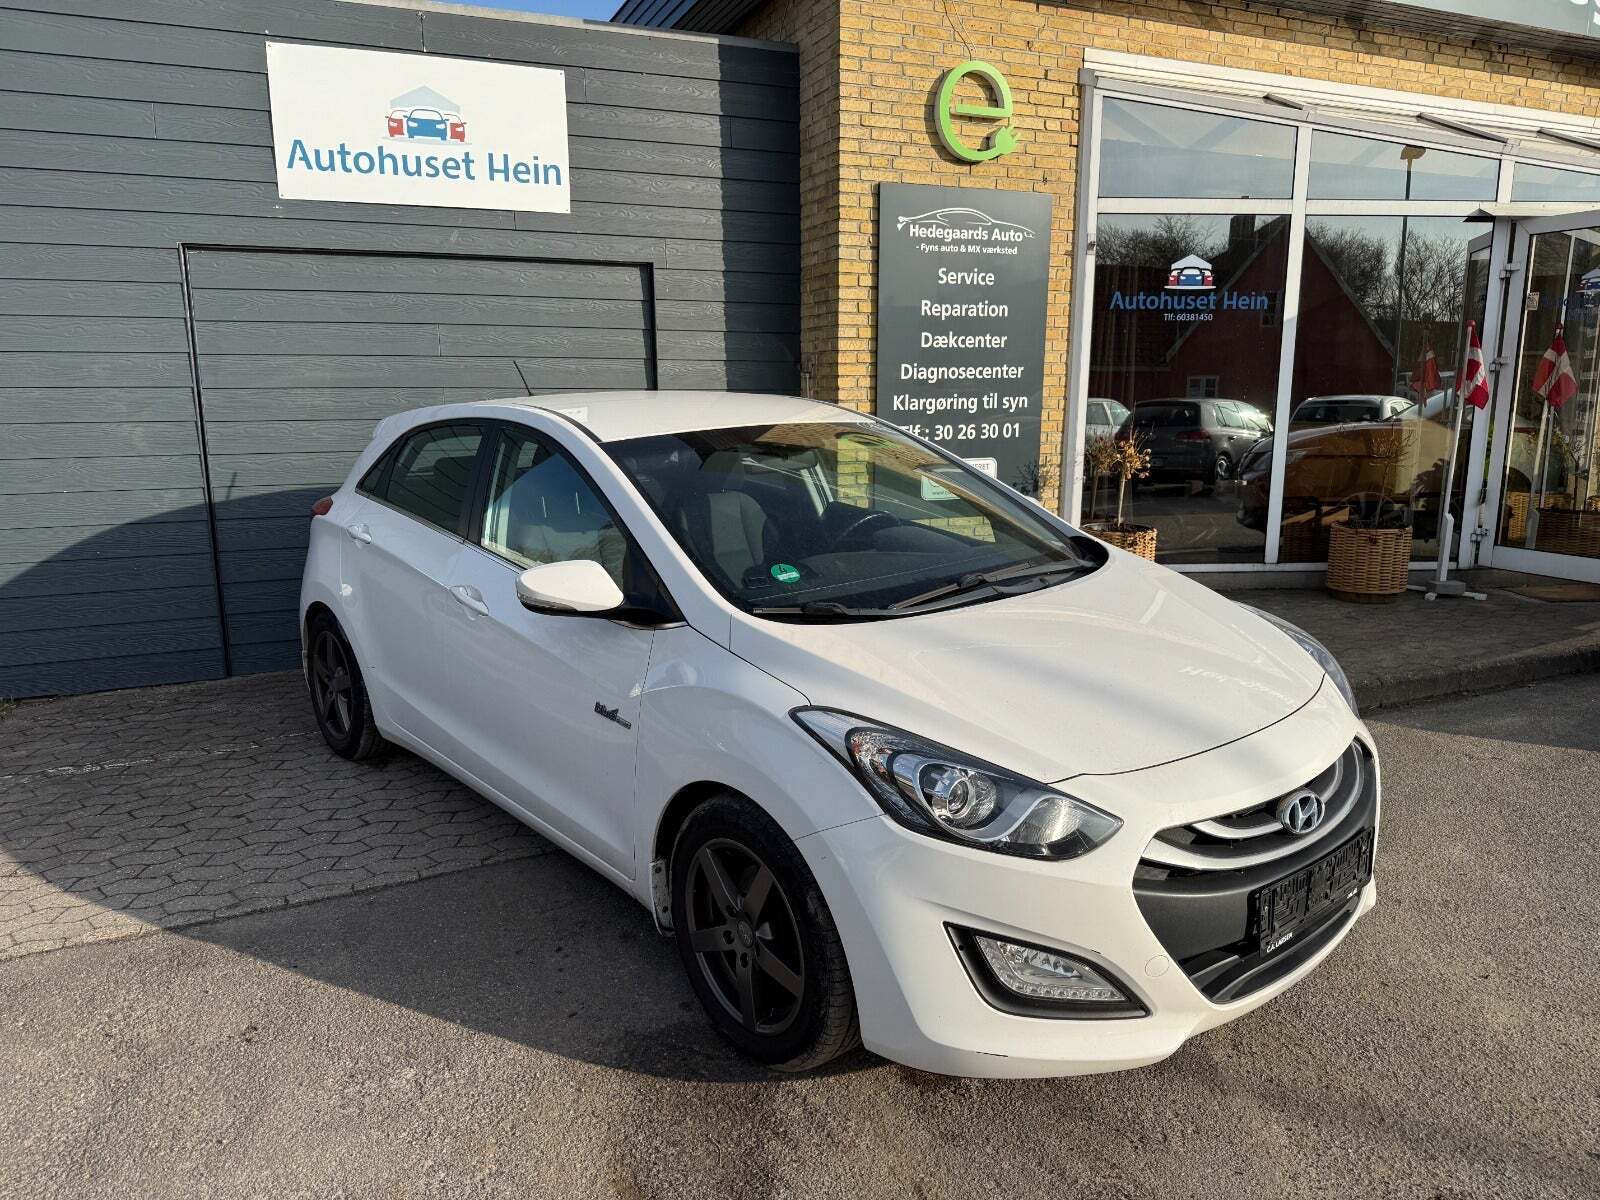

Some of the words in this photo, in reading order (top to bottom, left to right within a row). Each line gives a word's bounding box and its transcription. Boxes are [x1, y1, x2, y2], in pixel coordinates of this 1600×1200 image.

[286, 138, 476, 181] Autohuset
[487, 152, 563, 186] Hein
[909, 224, 989, 242] Hedegaards
[991, 228, 1024, 242] Auto
[920, 243, 939, 254] Fyns
[940, 244, 959, 253] auto
[960, 244, 967, 253] &
[967, 245, 981, 253] MX
[982, 246, 1018, 255] værksted
[938, 267, 995, 286] Service
[921, 299, 1009, 321] Reparation
[1109, 290, 1218, 311] Autohuset
[1223, 291, 1269, 311] Hein
[1163, 312, 1176, 321] Tlf:
[1176, 312, 1213, 321] 60381450
[920, 331, 1008, 349] Dækcenter
[900, 363, 1025, 384] Diagnosecenter
[893, 393, 978, 415] Klargøring
[982, 392, 998, 409] til
[1002, 395, 1028, 412] syn
[934, 424, 953, 441] 30
[957, 424, 976, 440] 26
[980, 423, 999, 440] 30
[1002, 422, 1020, 438] 01
